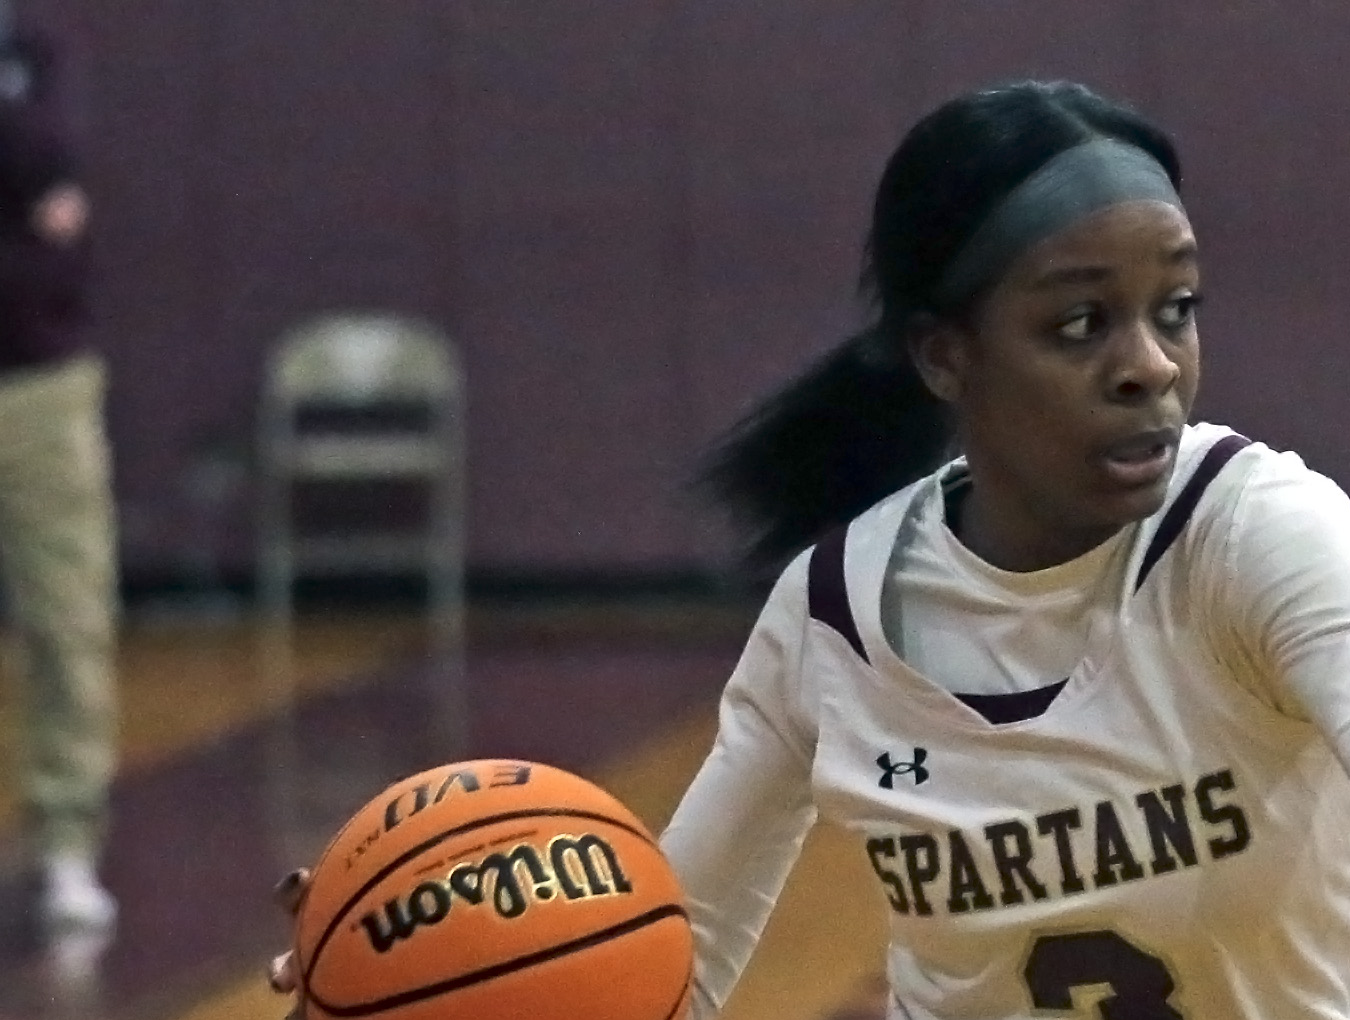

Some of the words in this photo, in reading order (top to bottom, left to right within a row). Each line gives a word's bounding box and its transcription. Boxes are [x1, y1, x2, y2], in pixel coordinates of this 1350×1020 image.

[385, 765, 531, 832] EVO
[866, 769, 1252, 915] SPARTANS
[360, 834, 633, 954] Wilson
